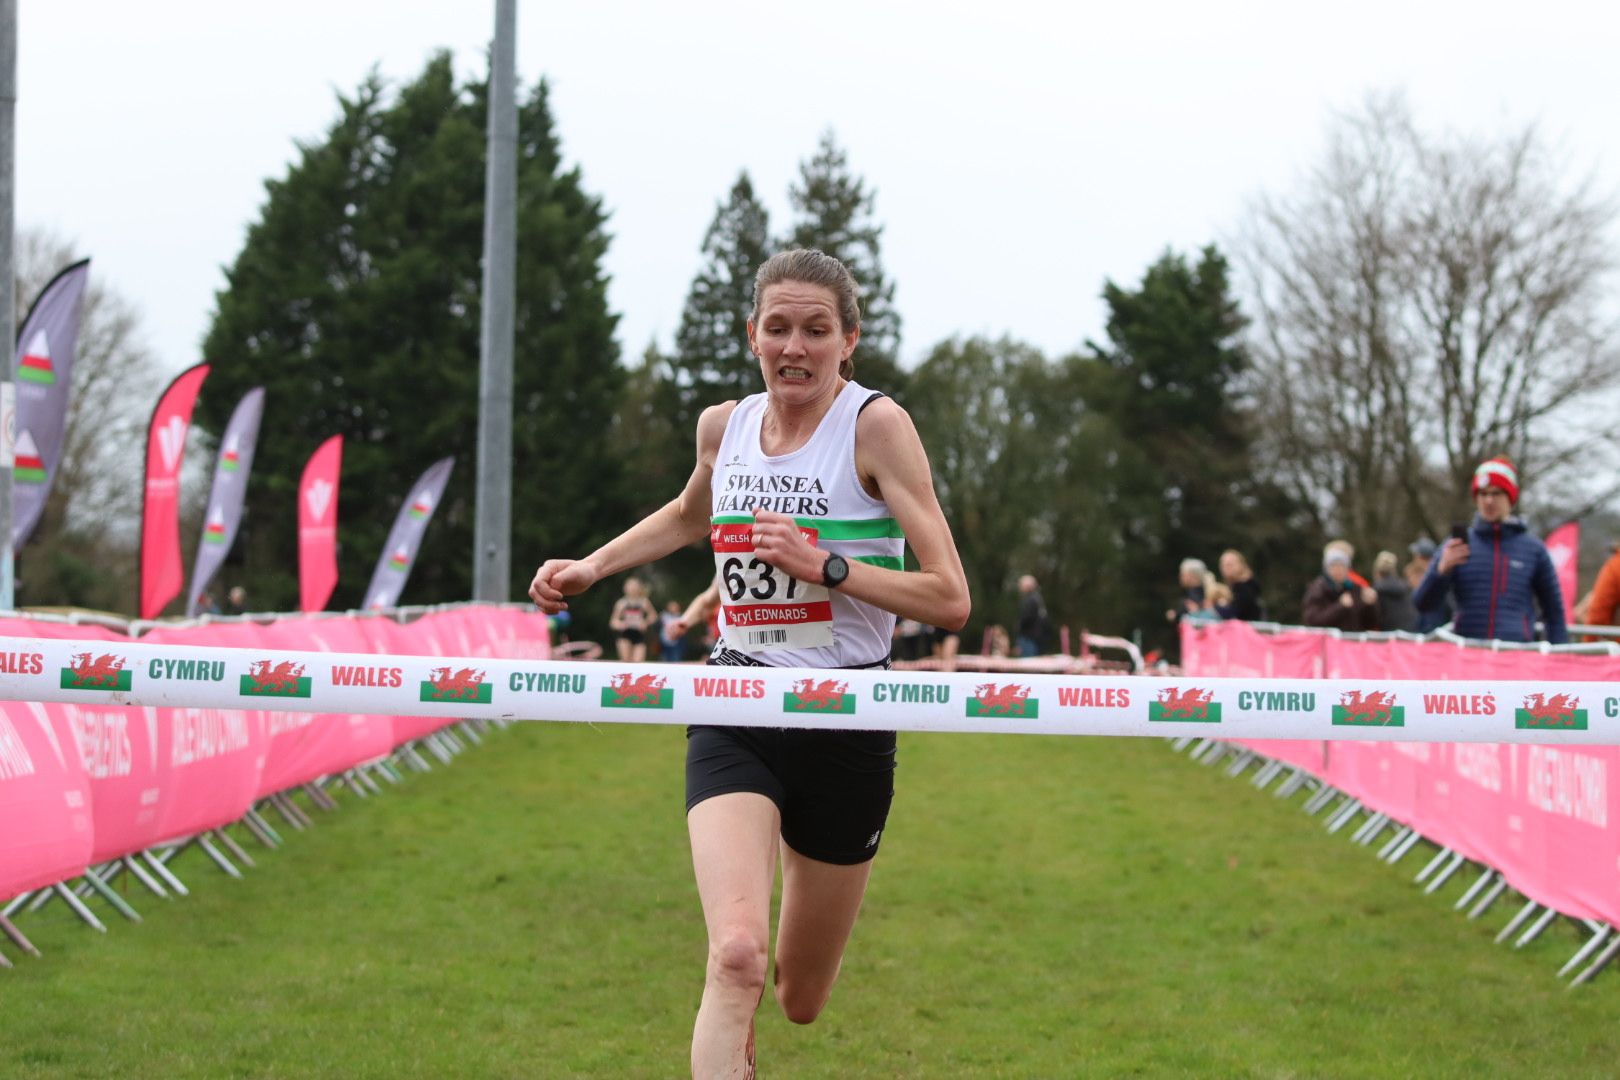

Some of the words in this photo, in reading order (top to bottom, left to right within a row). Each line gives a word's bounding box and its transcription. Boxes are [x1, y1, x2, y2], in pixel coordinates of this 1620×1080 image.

[725, 474, 824, 494] SWANSEA
[716, 495, 829, 516] HARRIERS
[723, 534, 750, 543] WELSH
[754, 607, 808, 621] EDWARDS
[0, 652, 43, 674] ALES
[149, 660, 224, 680] CYMRU
[332, 667, 401, 687] WALES
[510, 673, 585, 692] CYMRU
[694, 678, 764, 698] WALES
[874, 684, 948, 702] CYMRU
[1059, 688, 1129, 707] WALES
[1239, 693, 1314, 711] CYMRU
[1424, 694, 1495, 715] WALES
